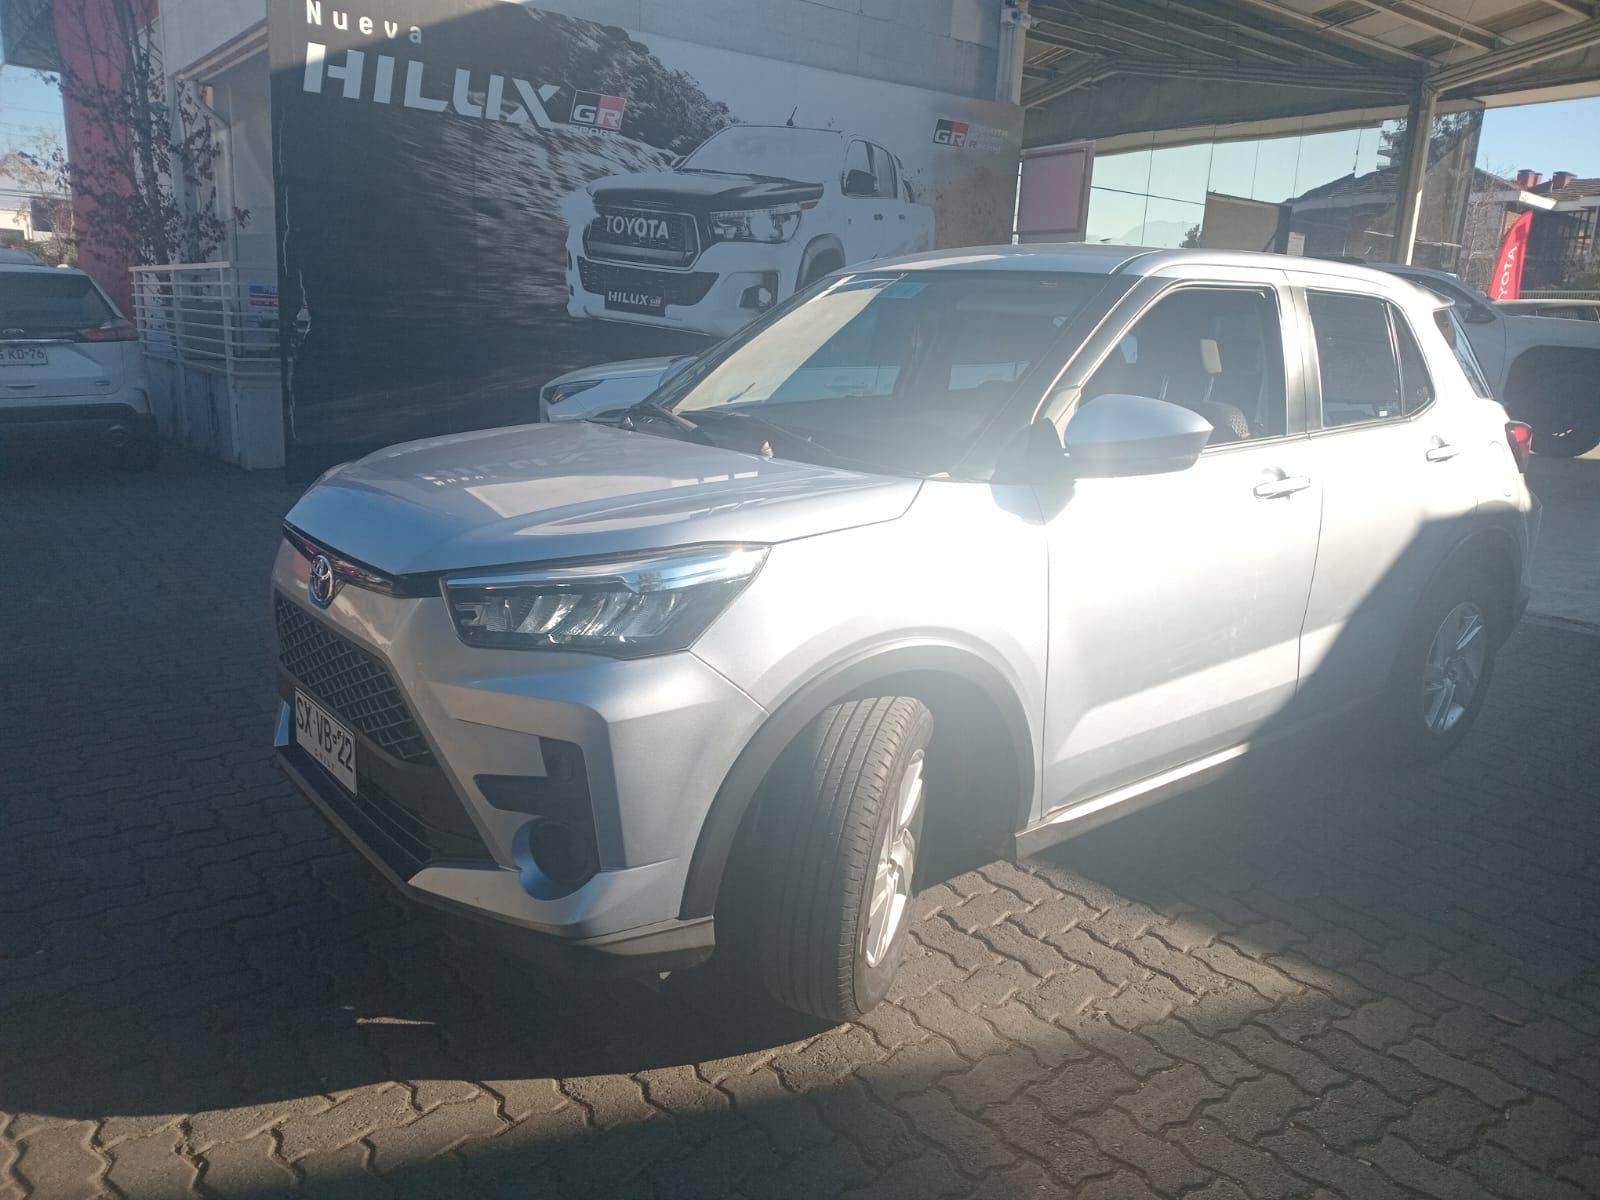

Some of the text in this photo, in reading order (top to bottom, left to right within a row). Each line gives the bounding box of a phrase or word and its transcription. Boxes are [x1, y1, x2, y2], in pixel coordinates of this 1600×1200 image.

[305, 1, 423, 44] Nueva
[303, 42, 561, 130] HILUX
[572, 104, 622, 127] GR
[934, 129, 966, 147] GR
[605, 215, 669, 239] TOYOTA
[607, 290, 649, 306] HILUX
